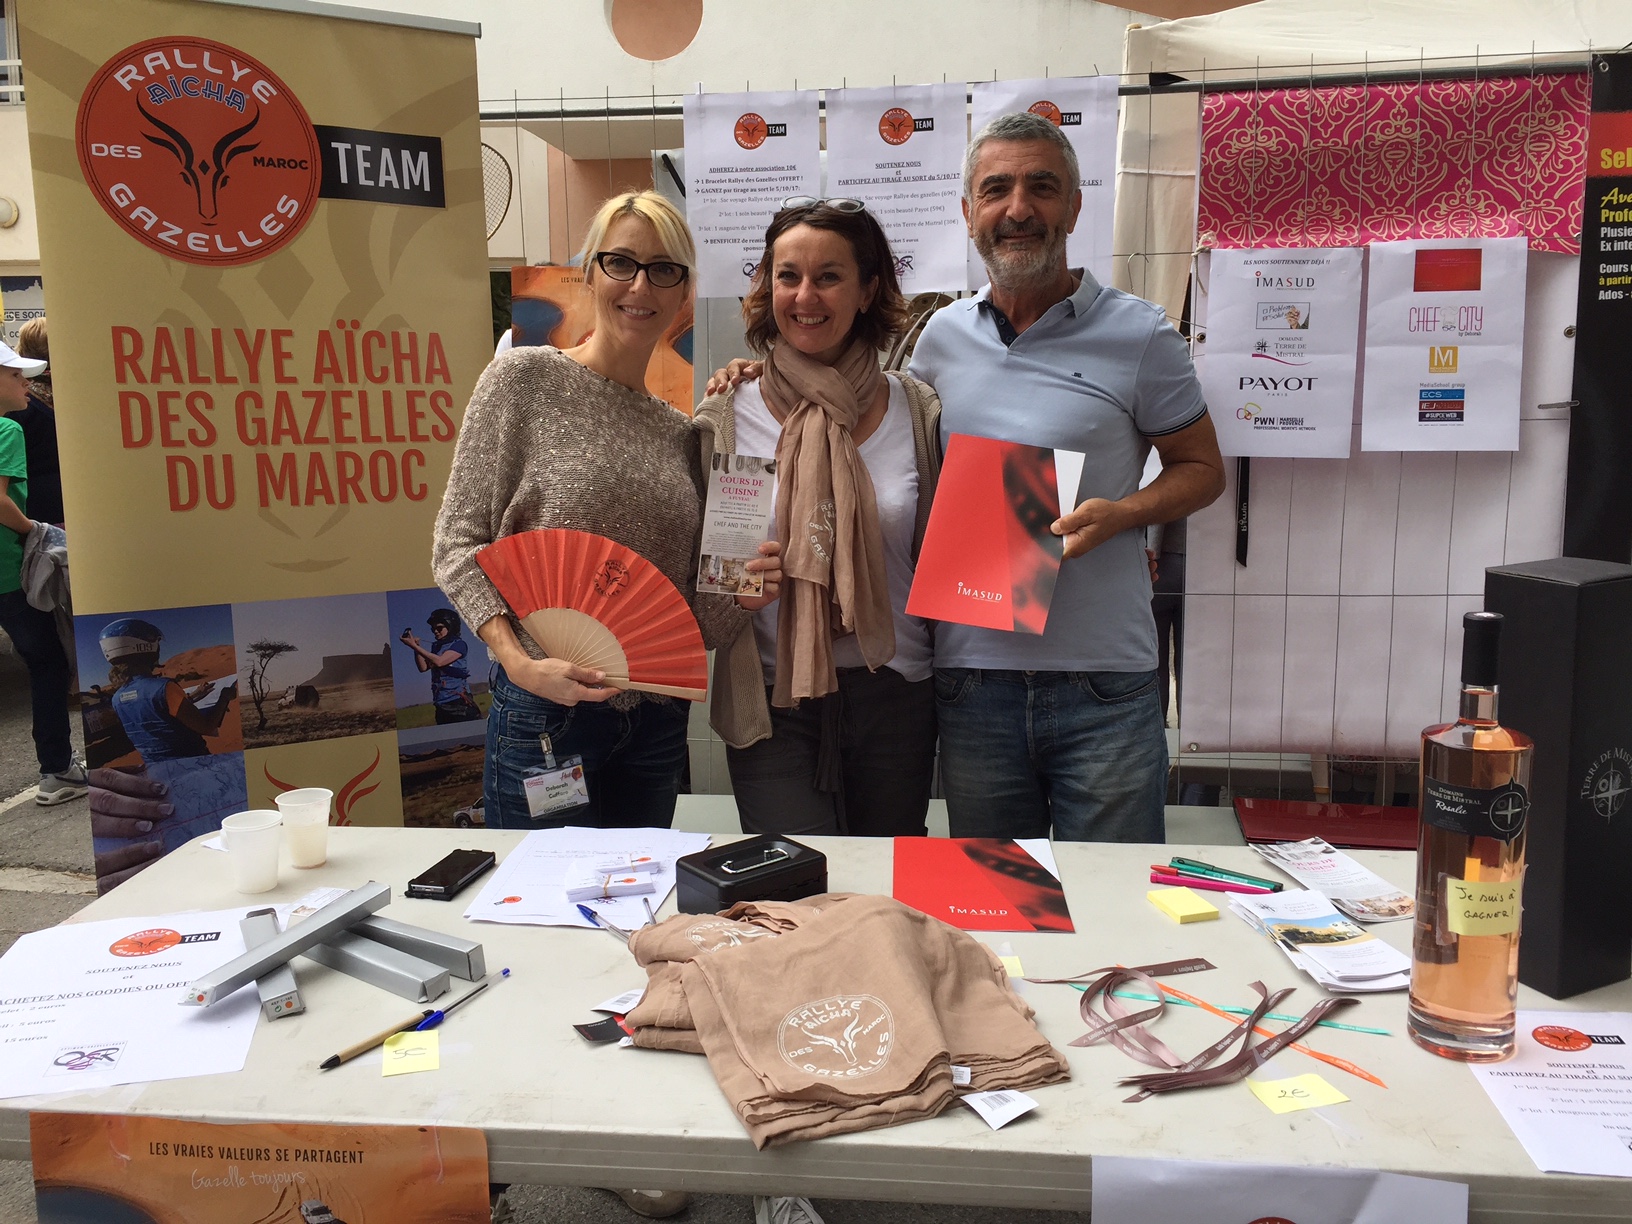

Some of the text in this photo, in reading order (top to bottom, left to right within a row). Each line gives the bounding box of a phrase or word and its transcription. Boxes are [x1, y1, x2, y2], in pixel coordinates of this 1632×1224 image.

[113, 48, 277, 104] RALLYE
[146, 74, 247, 113] AÏCHA
[915, 121, 932, 129] TEAM
[1063, 114, 1080, 123] TEAM
[91, 143, 142, 159] DES
[253, 156, 308, 171] MAROC
[331, 142, 430, 191] TEAM
[109, 183, 299, 253] GAZELLES
[1600, 241, 1611, 251] Ex
[1600, 264, 1628, 273] Cours
[1606, 275, 1631, 286] partir
[1599, 290, 1624, 300] Ados
[1408, 306, 1483, 332] CHEF CITY
[111, 319, 452, 385] RALLYE AÏCHA
[1239, 377, 1318, 390] PAYOT
[118, 389, 455, 448] DES GAZELLES
[166, 448, 429, 512] DU MAROC
[720, 476, 764, 487] COURS DE
[722, 486, 759, 497] CUISINE
[1580, 750, 1612, 799] TERRE DE
[1427, 788, 1442, 798] TERRE
[1452, 796, 1481, 805] MISTRAL
[1439, 787, 1464, 797] DOMAINE
[1435, 800, 1467, 815] Rosalie
[1455, 886, 1516, 902] Je suis à
[184, 934, 216, 942] TEAM
[85, 965, 149, 975] SOUTENEZ
[86, 985, 142, 997] GOODIES
[788, 1000, 862, 1027] RALLYE
[862, 1014, 886, 1035] MAROC
[789, 1046, 813, 1058] DES
[803, 1032, 889, 1077] GAZELLES
[149, 1141, 364, 1165] LES VRAIES VALEURS SE PARTAGENT
[190, 1166, 306, 1193] Gazelle toujours
